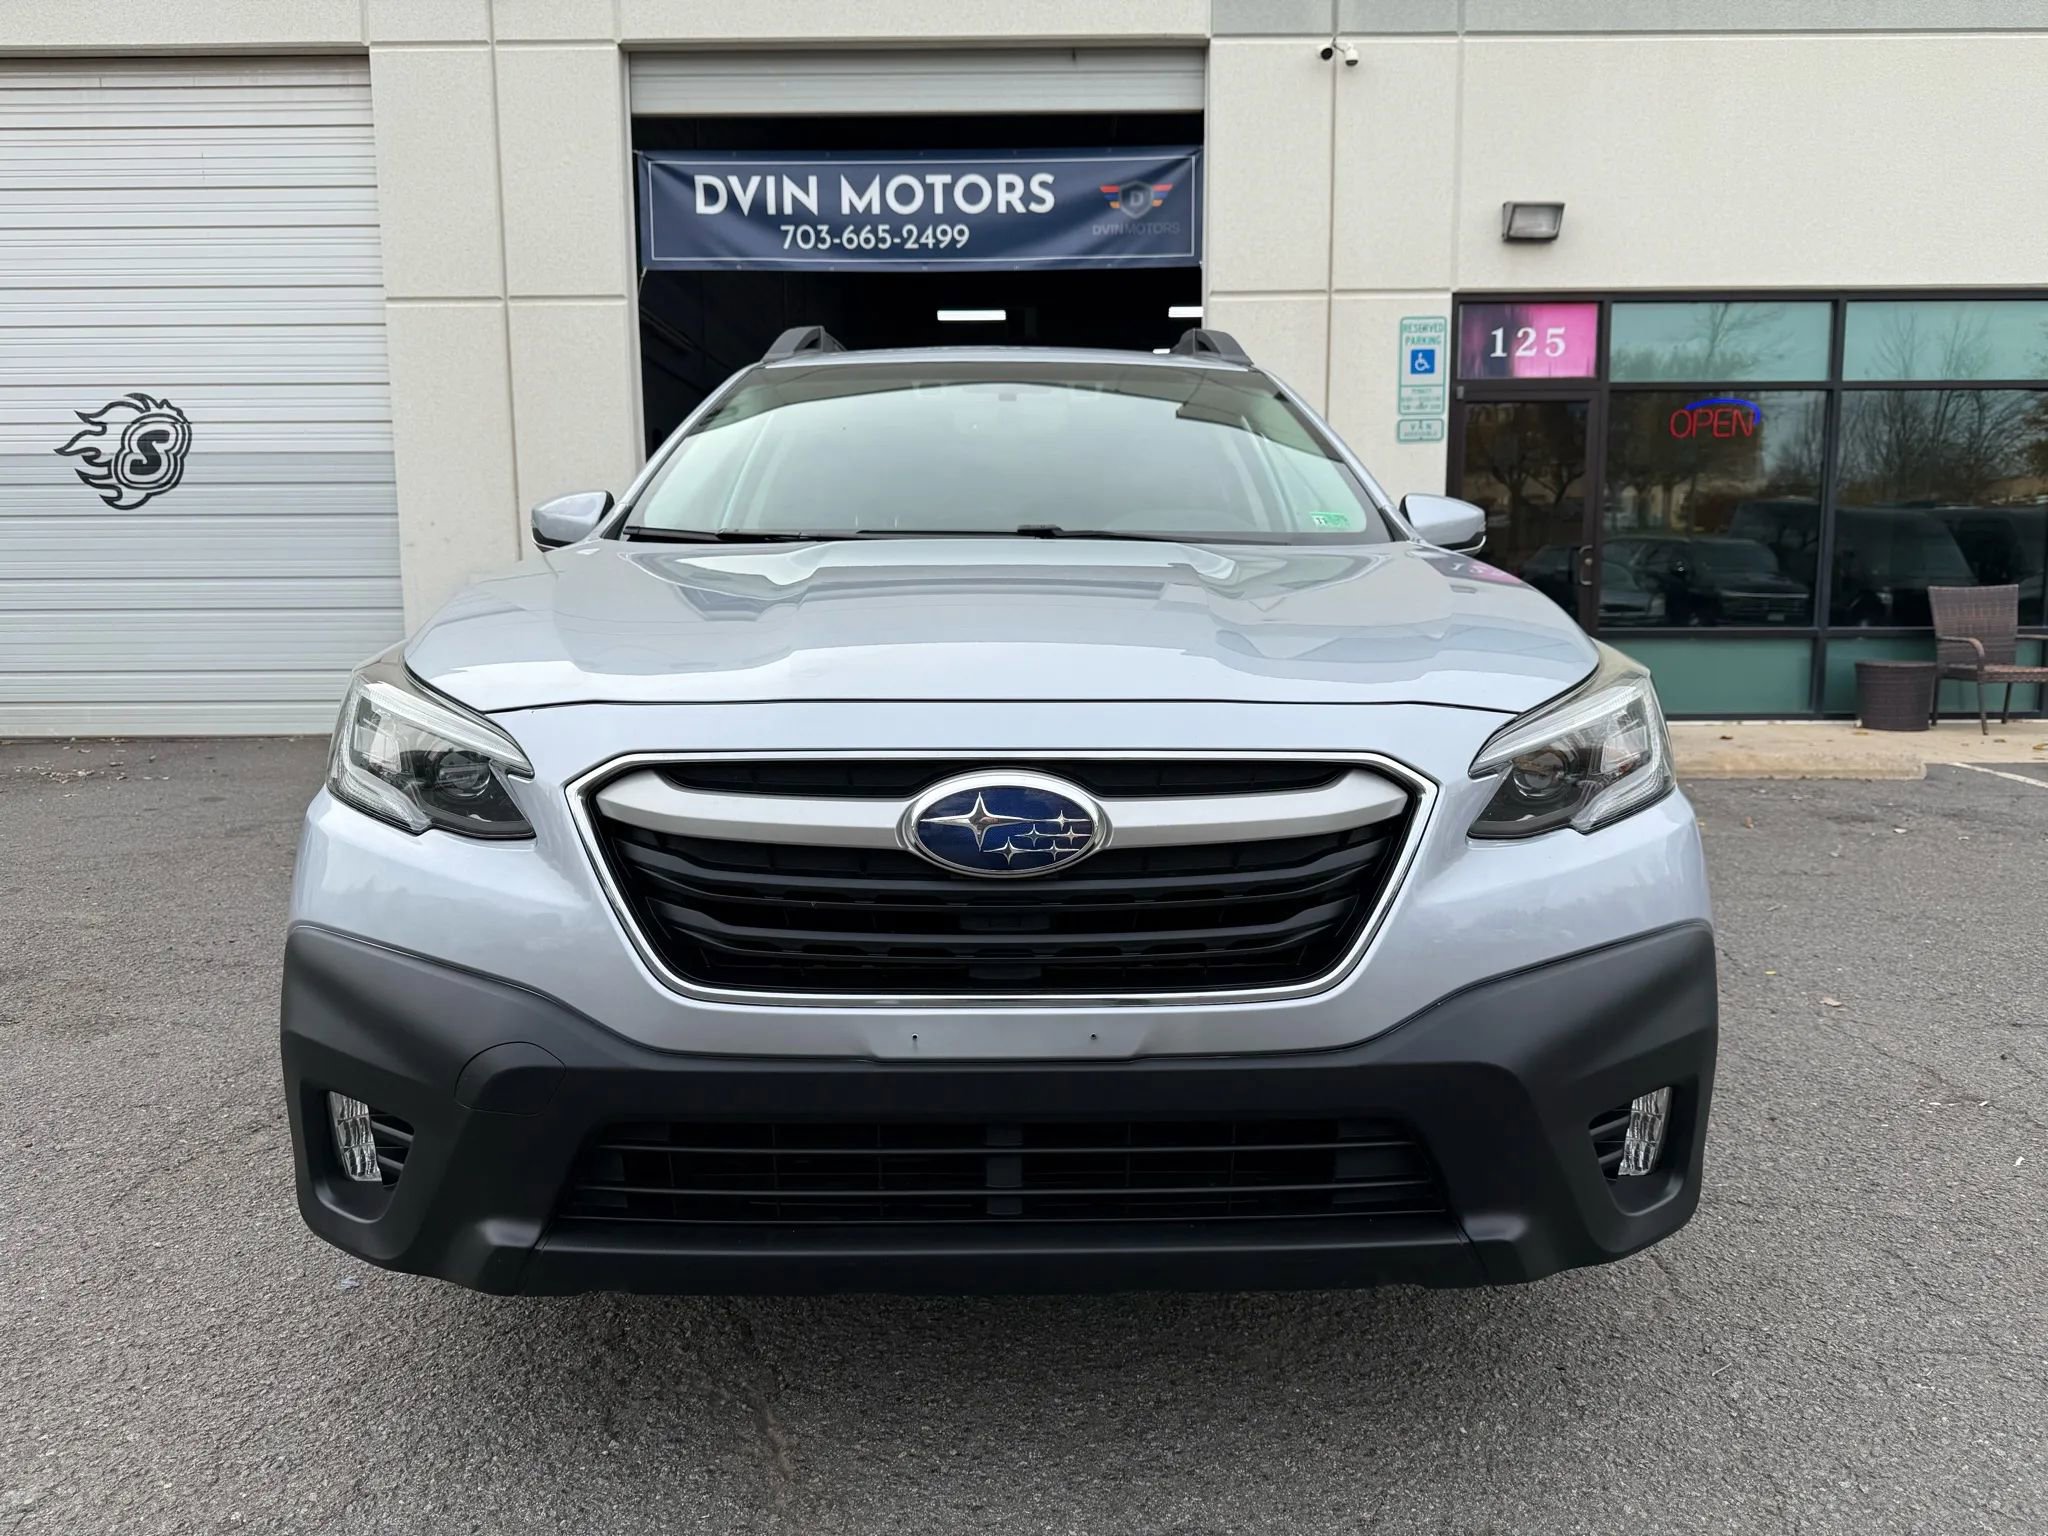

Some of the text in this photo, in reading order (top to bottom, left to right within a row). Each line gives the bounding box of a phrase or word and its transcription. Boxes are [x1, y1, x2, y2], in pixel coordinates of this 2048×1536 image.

[694, 173, 1056, 216] DVIN MOTORS
[1130, 191, 1144, 206] D
[780, 224, 970, 250] 703-665-2499
[1403, 322, 1444, 334] RESERVED
[1405, 335, 1442, 346] PARKING
[1489, 327, 1566, 358] 125
[1669, 408, 1754, 438] OPEN
